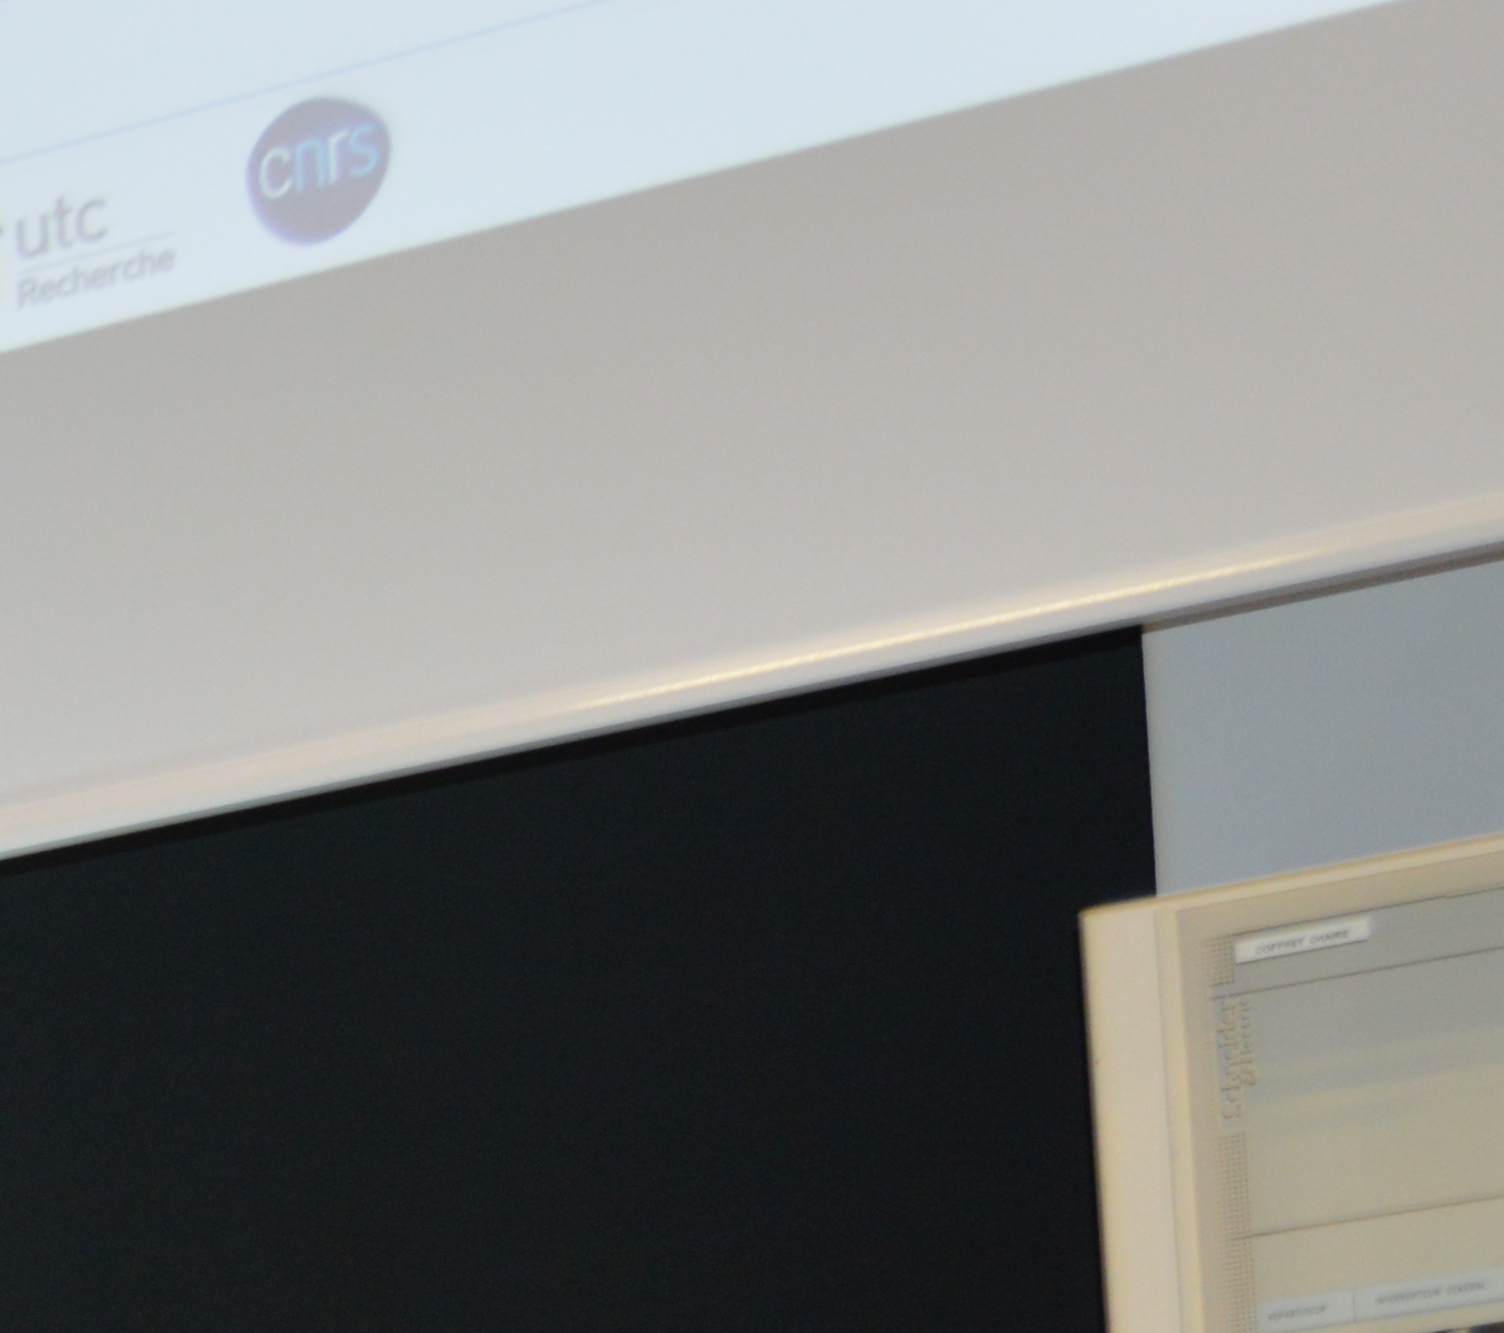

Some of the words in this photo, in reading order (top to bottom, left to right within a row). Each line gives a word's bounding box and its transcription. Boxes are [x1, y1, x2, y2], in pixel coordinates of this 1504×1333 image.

[258, 120, 380, 200] cnrs
[15, 196, 108, 261] utc
[17, 246, 175, 308] Recherche
[1255, 937, 1304, 954] COFFRET
[1309, 928, 1350, 944] CHAIRE
